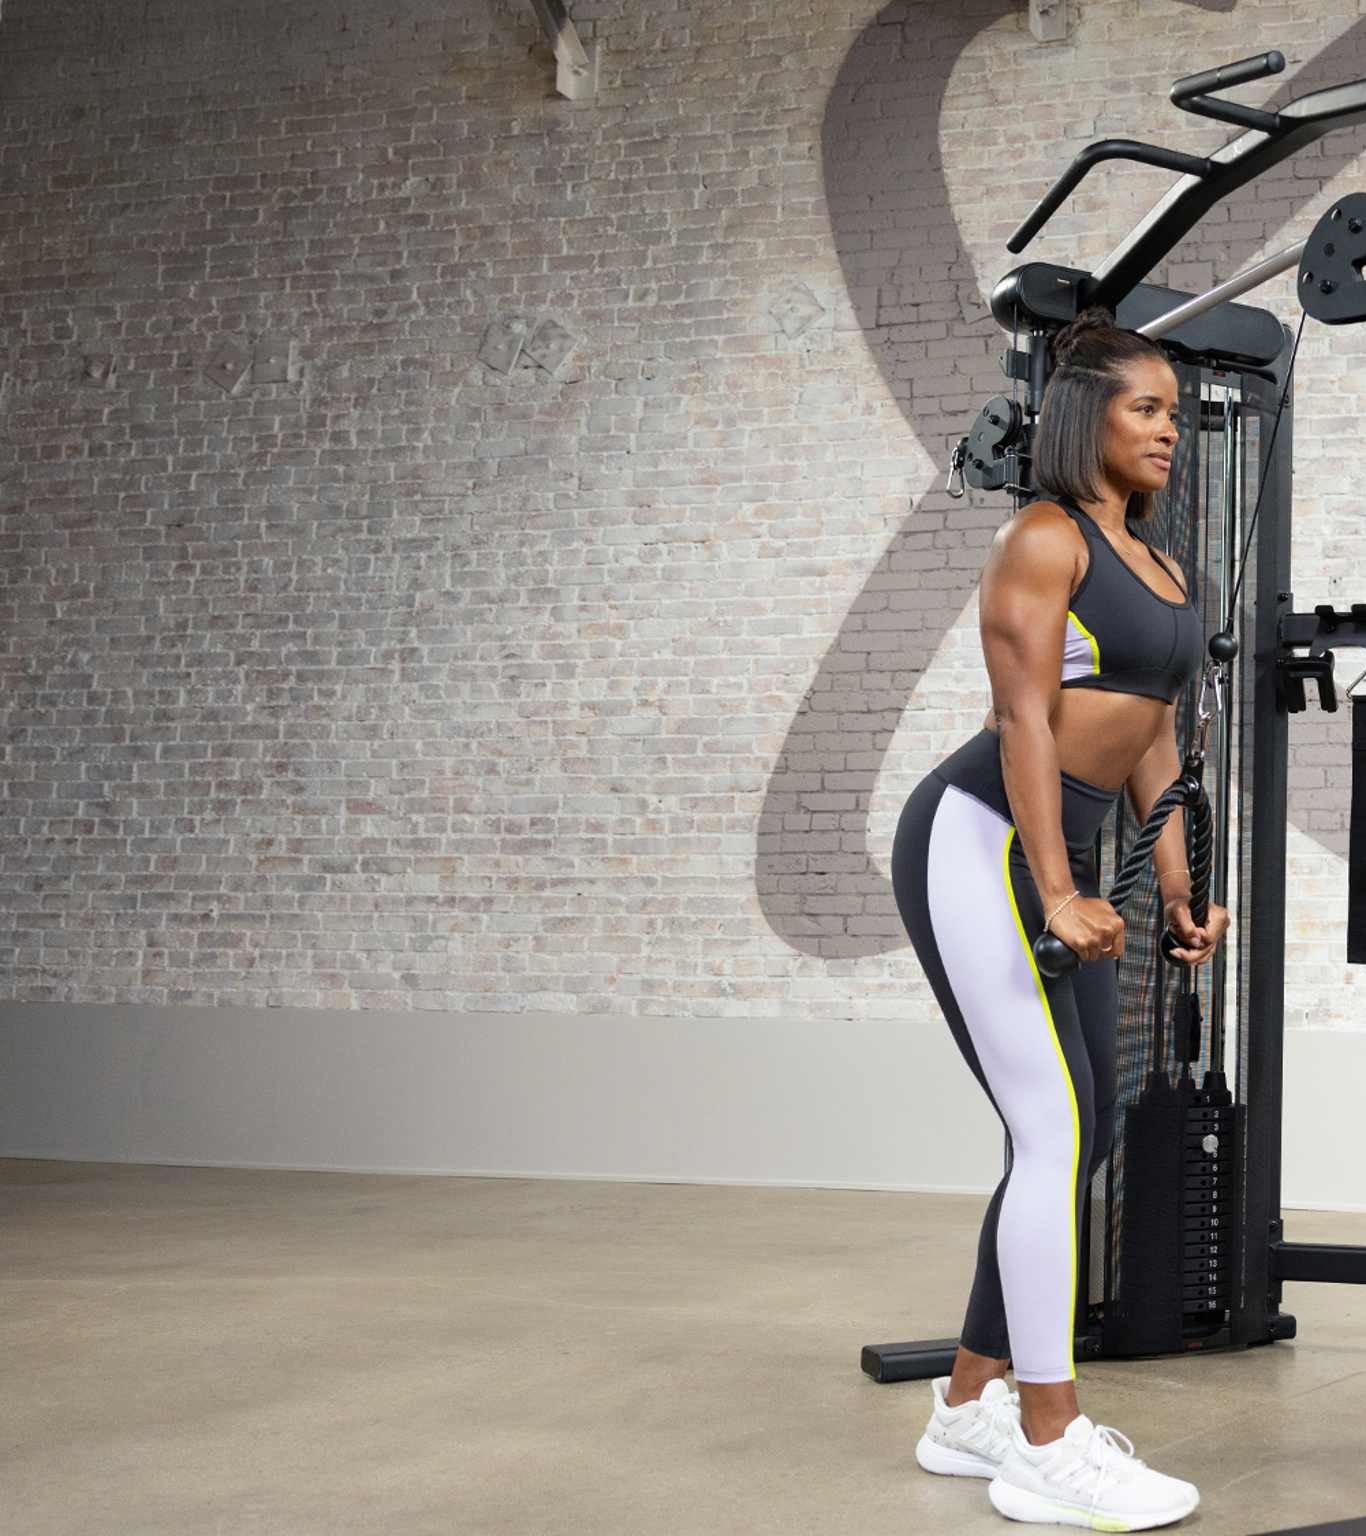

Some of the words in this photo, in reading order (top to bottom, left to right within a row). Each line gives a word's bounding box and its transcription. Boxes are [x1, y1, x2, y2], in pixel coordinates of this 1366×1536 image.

[1210, 1218, 1219, 1227] 10
[1210, 1232, 1218, 1240] 11
[1209, 1245, 1218, 1254] 12
[1208, 1259, 1218, 1268] 13
[1208, 1273, 1217, 1282] 14
[1208, 1286, 1217, 1295] 15
